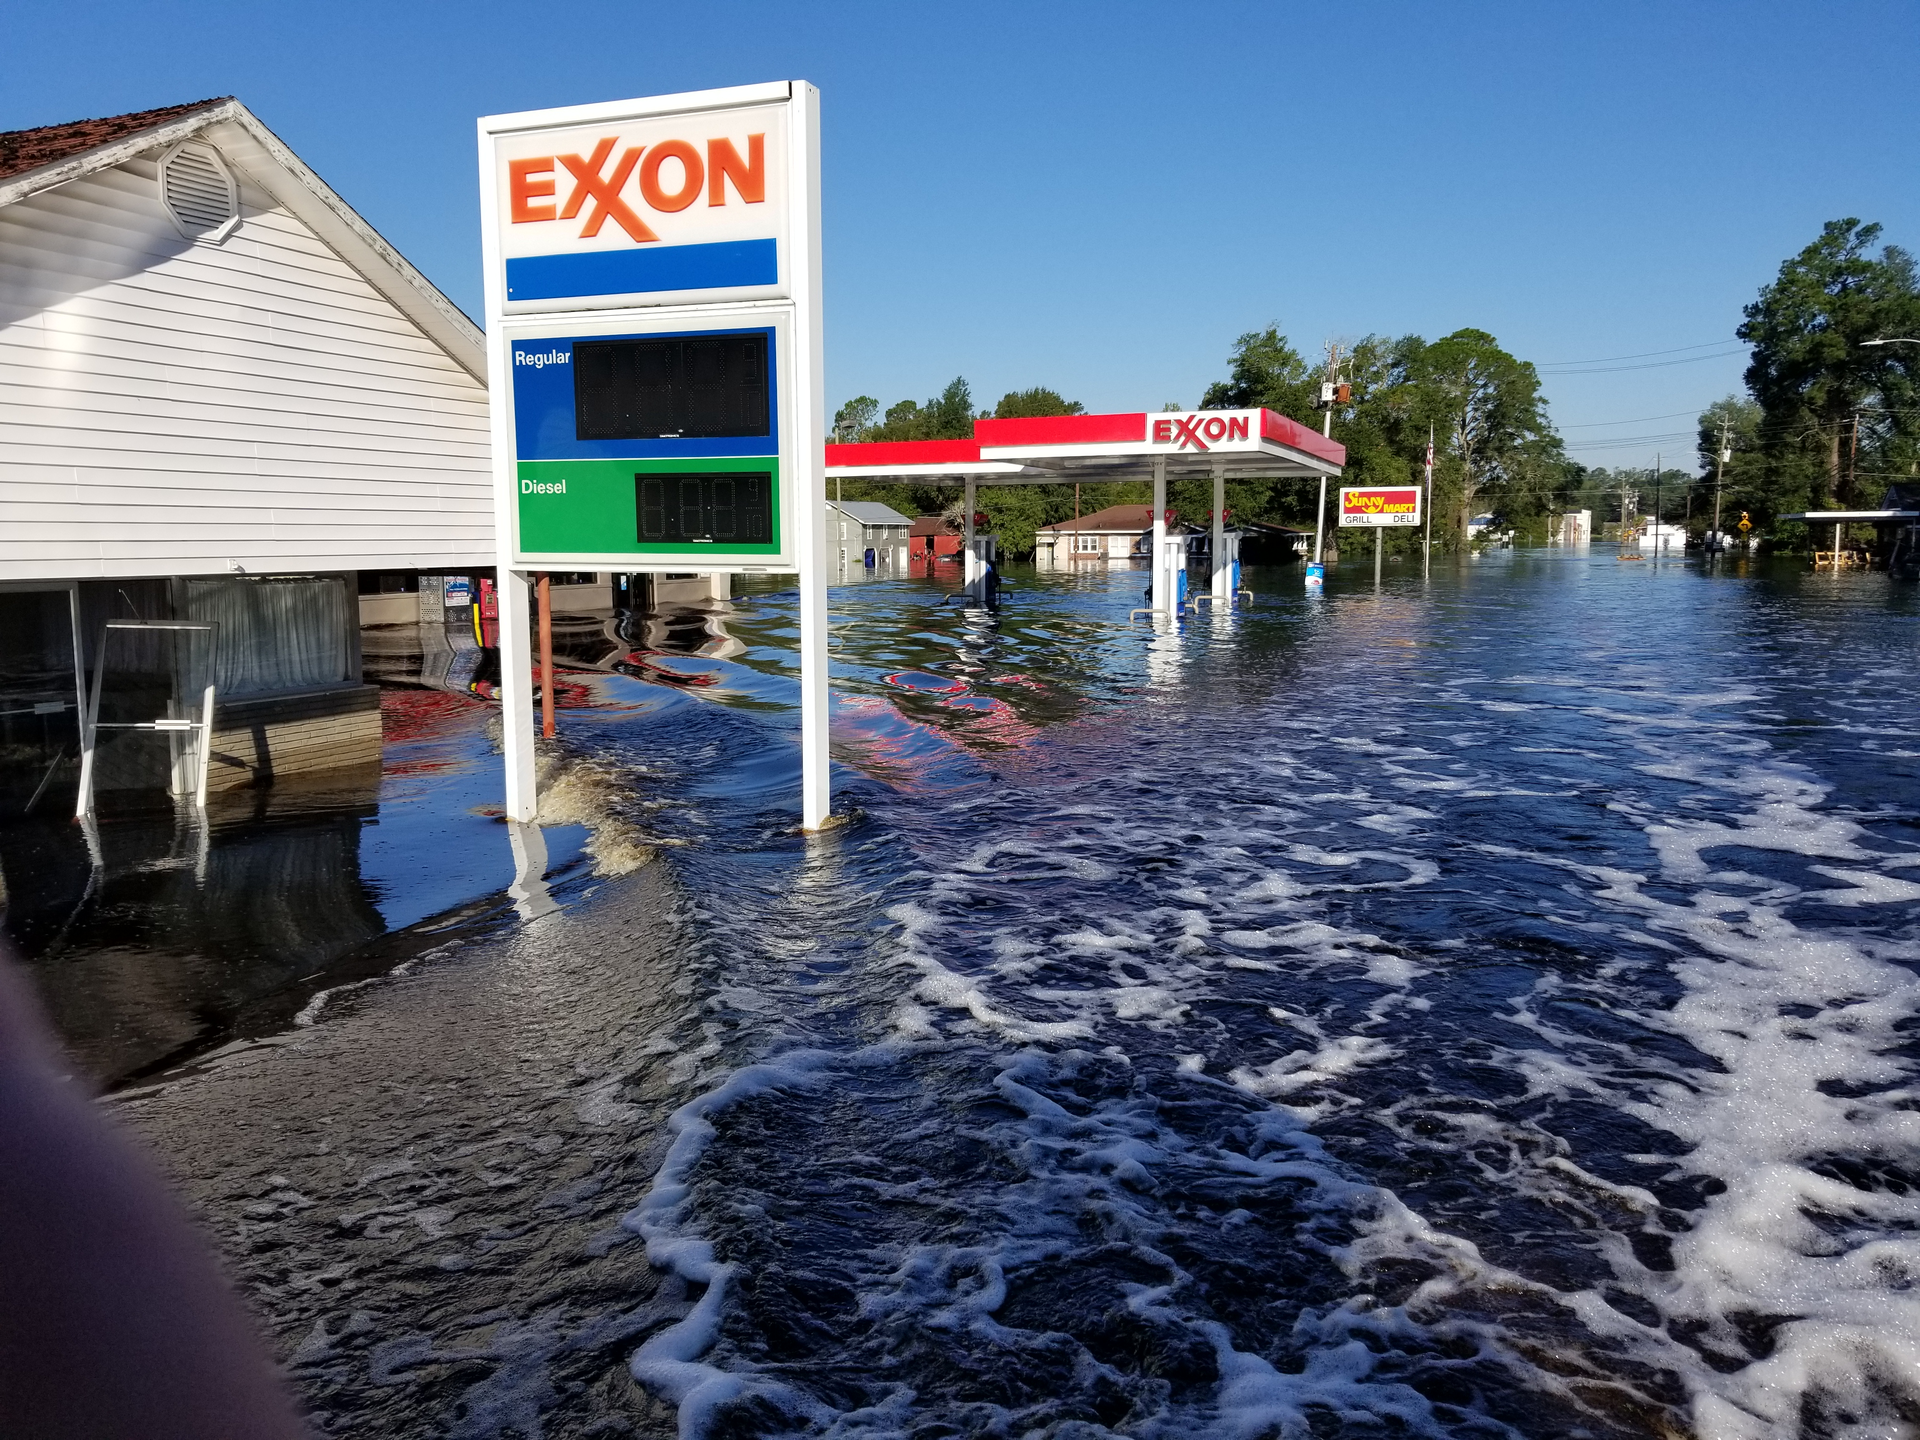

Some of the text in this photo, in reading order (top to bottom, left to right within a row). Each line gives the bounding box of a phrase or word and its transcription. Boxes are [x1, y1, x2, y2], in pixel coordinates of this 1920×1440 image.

[508, 132, 766, 243] EXXON
[515, 349, 571, 369] Regular
[1153, 414, 1249, 451] EXXON
[521, 479, 567, 494] Diesel
[1383, 503, 1415, 513] MART
[1345, 514, 1415, 524] GRILL DELI
